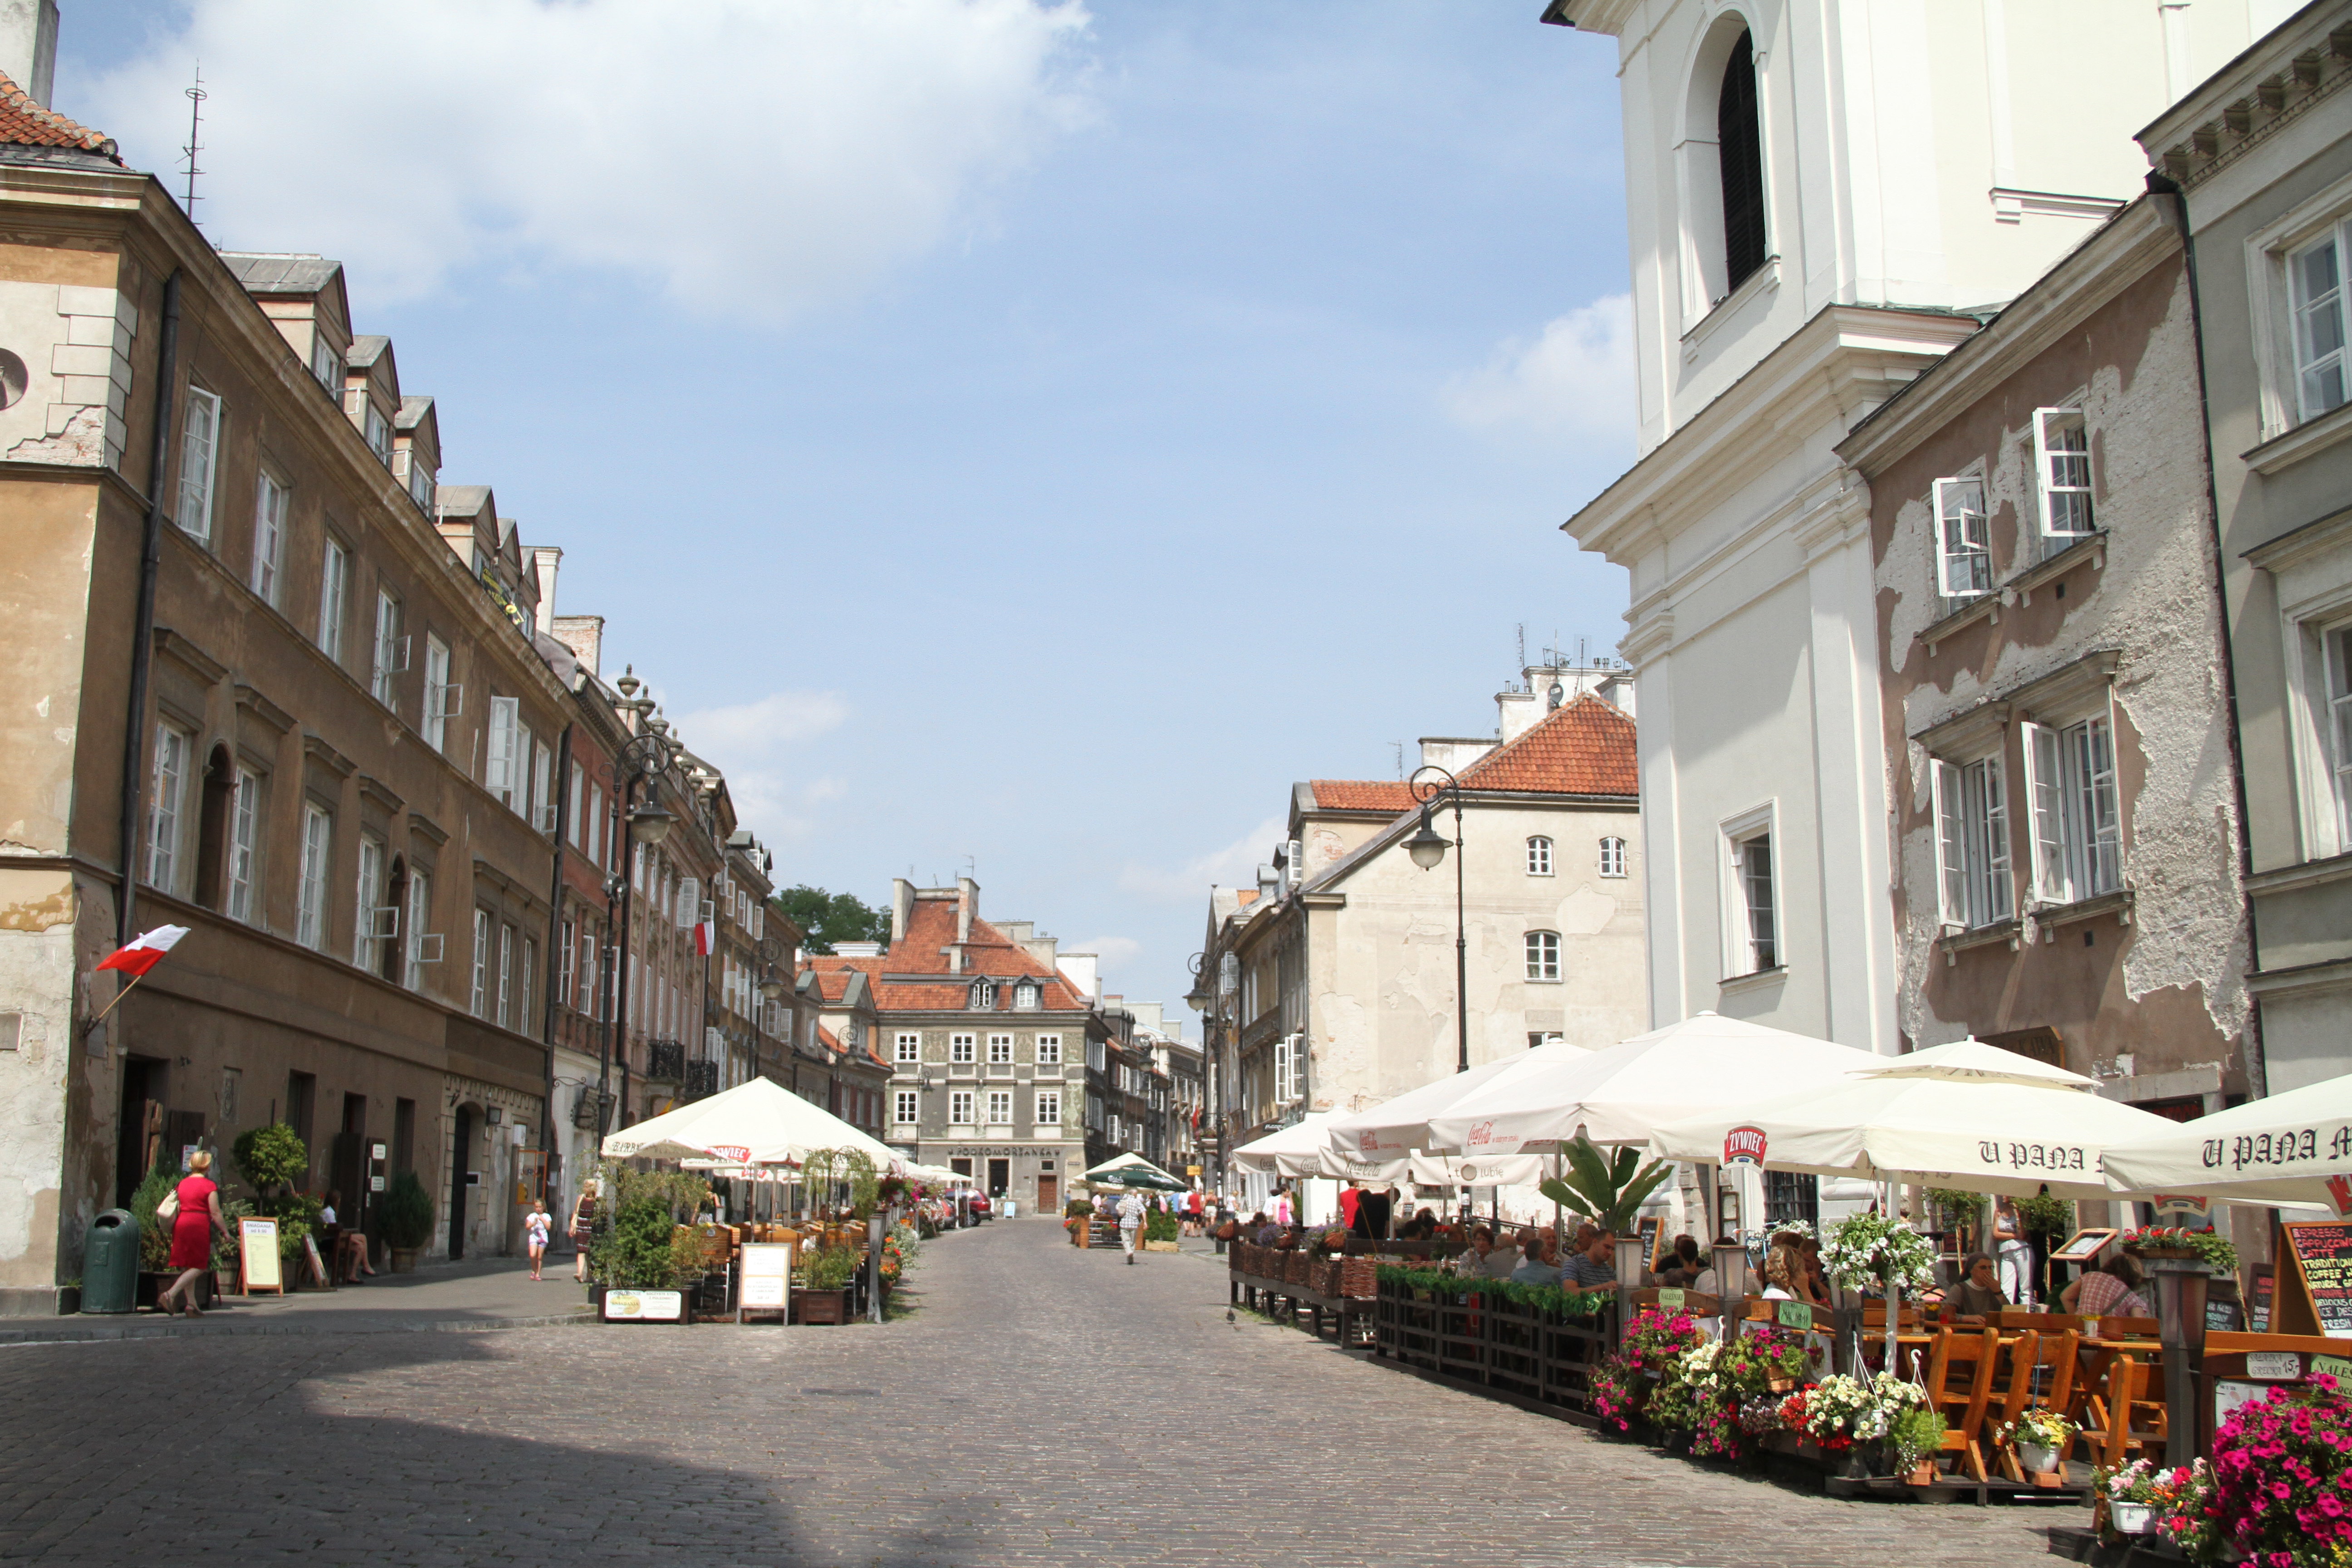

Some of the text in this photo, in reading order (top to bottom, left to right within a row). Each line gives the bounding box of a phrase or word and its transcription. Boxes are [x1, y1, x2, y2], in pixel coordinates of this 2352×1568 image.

[1729, 1131, 1763, 1154] ŻYWIEC
[2202, 1138, 2224, 1167] U
[2231, 1128, 2318, 1171] PANA
[1978, 1141, 2000, 1163] U
[2009, 1142, 2084, 1170] PANA
[2292, 1228, 2345, 1238] ESPRESSO
[2298, 1249, 2336, 1259] LATTE
[2306, 1269, 2342, 1279] COFFEE
[2307, 1279, 2343, 1289] NATURAL
[2321, 1318, 2352, 1329] FRESH
